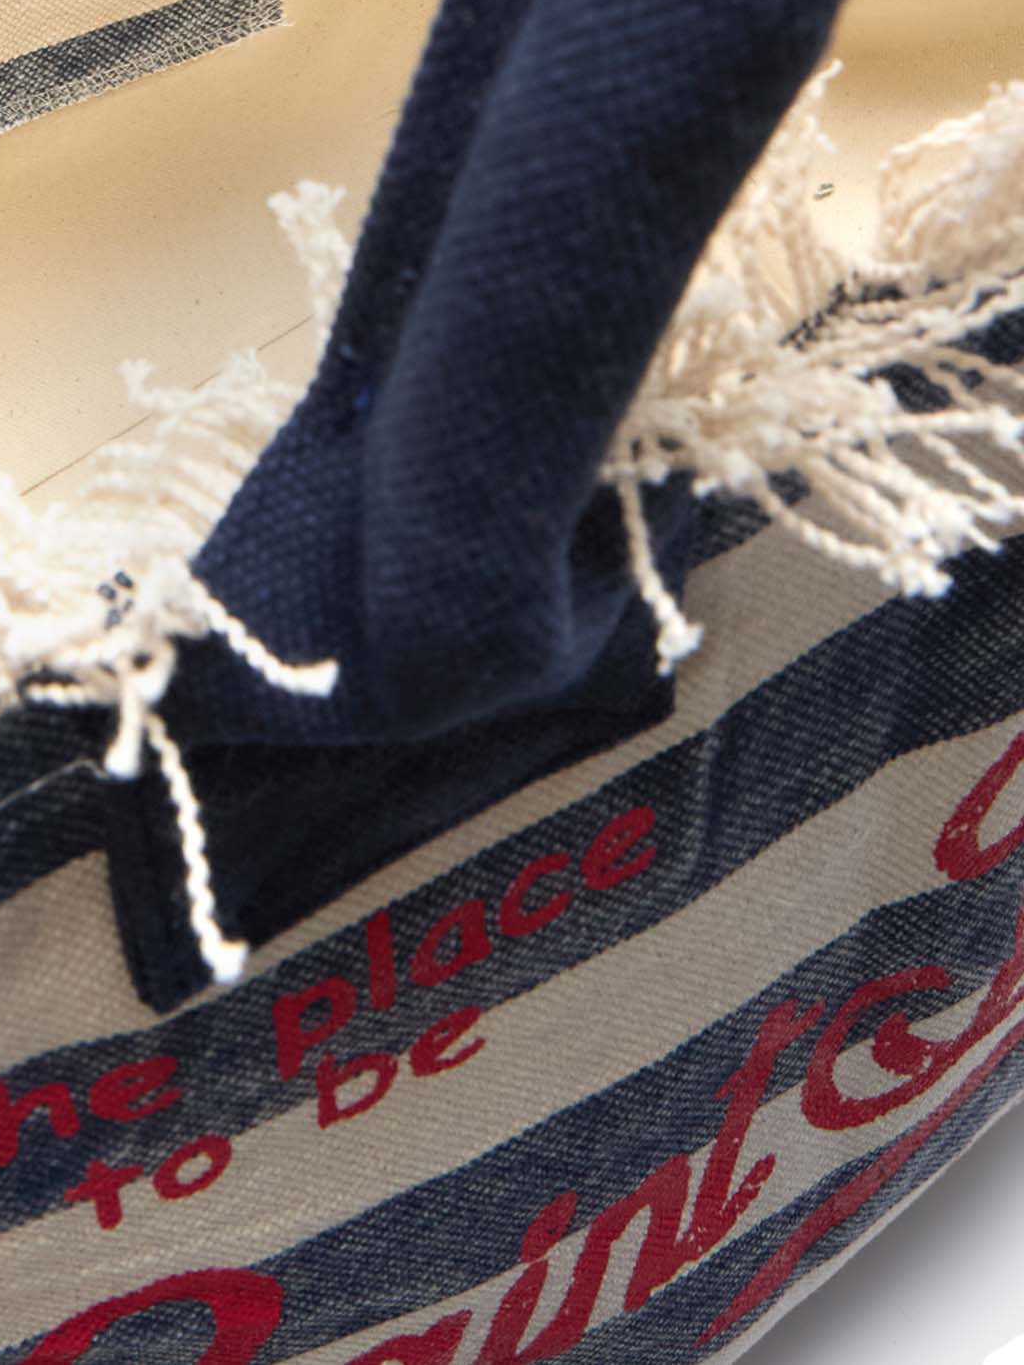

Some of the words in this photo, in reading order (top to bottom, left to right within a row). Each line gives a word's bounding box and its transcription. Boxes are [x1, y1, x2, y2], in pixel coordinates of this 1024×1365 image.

[272, 805, 656, 1081] place
[64, 1135, 231, 1229] to
[315, 1006, 485, 1127] be
